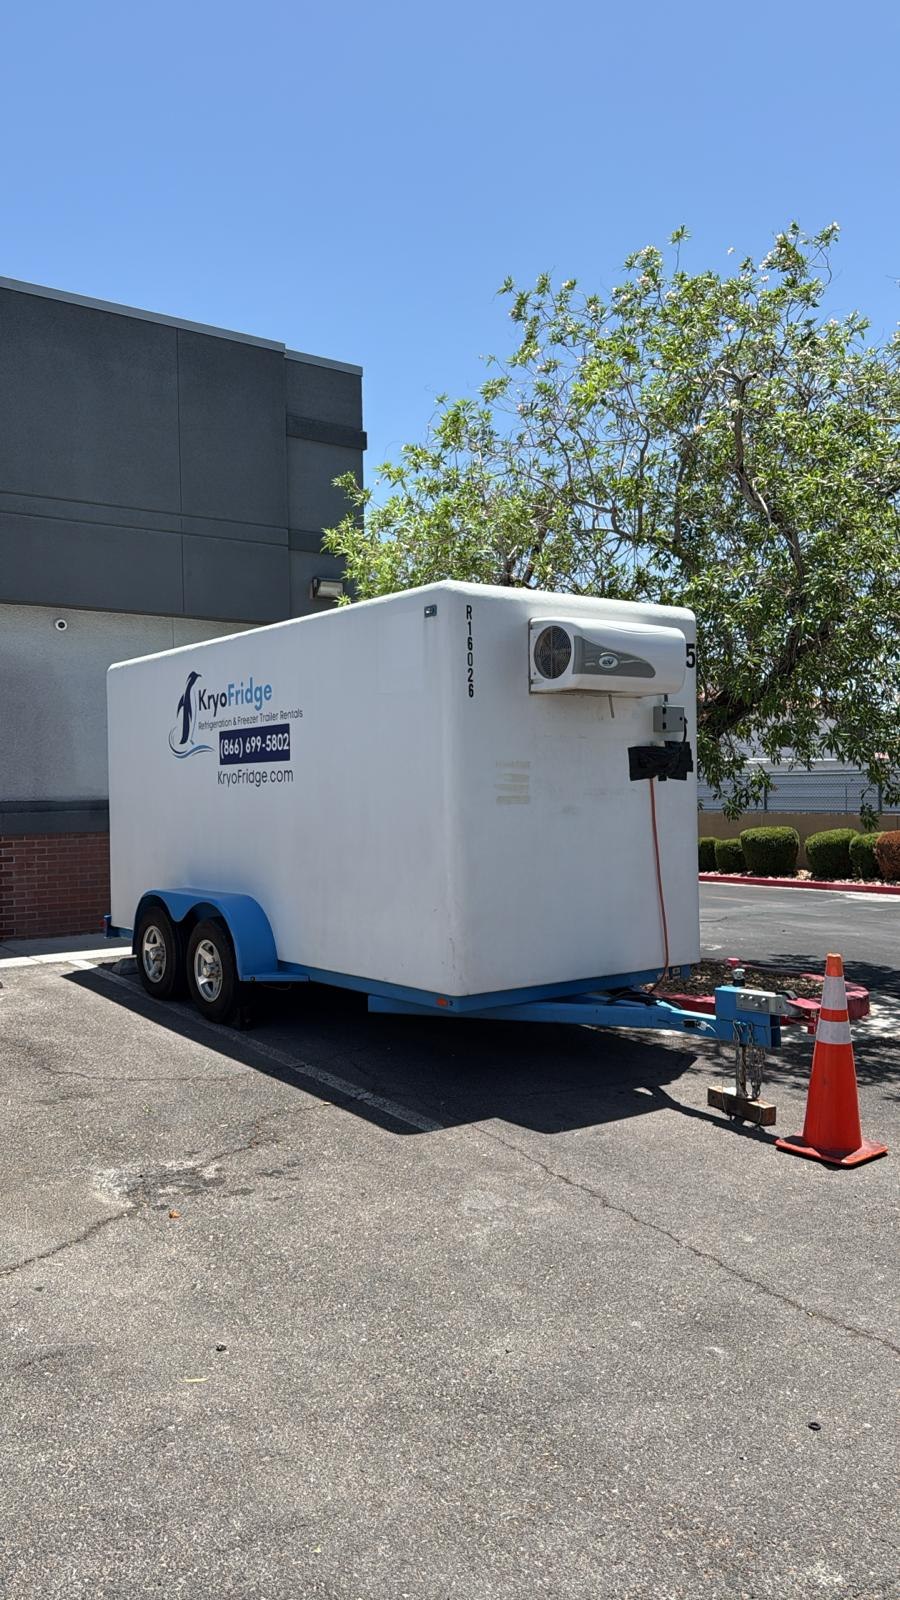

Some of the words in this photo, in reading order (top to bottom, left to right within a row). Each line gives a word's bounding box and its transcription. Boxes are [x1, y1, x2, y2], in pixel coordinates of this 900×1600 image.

[466, 604, 474, 698] R16026
[686, 643, 696, 668] 5
[199, 677, 272, 717] KryoFridge
[198, 719, 232, 731] Refrigeration
[233, 717, 237, 726] &
[237, 715, 259, 724] Freezer
[260, 712, 279, 721] Trailer
[280, 709, 303, 719] Rentals
[220, 737, 243, 759] (866)
[246, 733, 290, 753] 699-5802
[217, 768, 294, 788] KryoFridge.com
